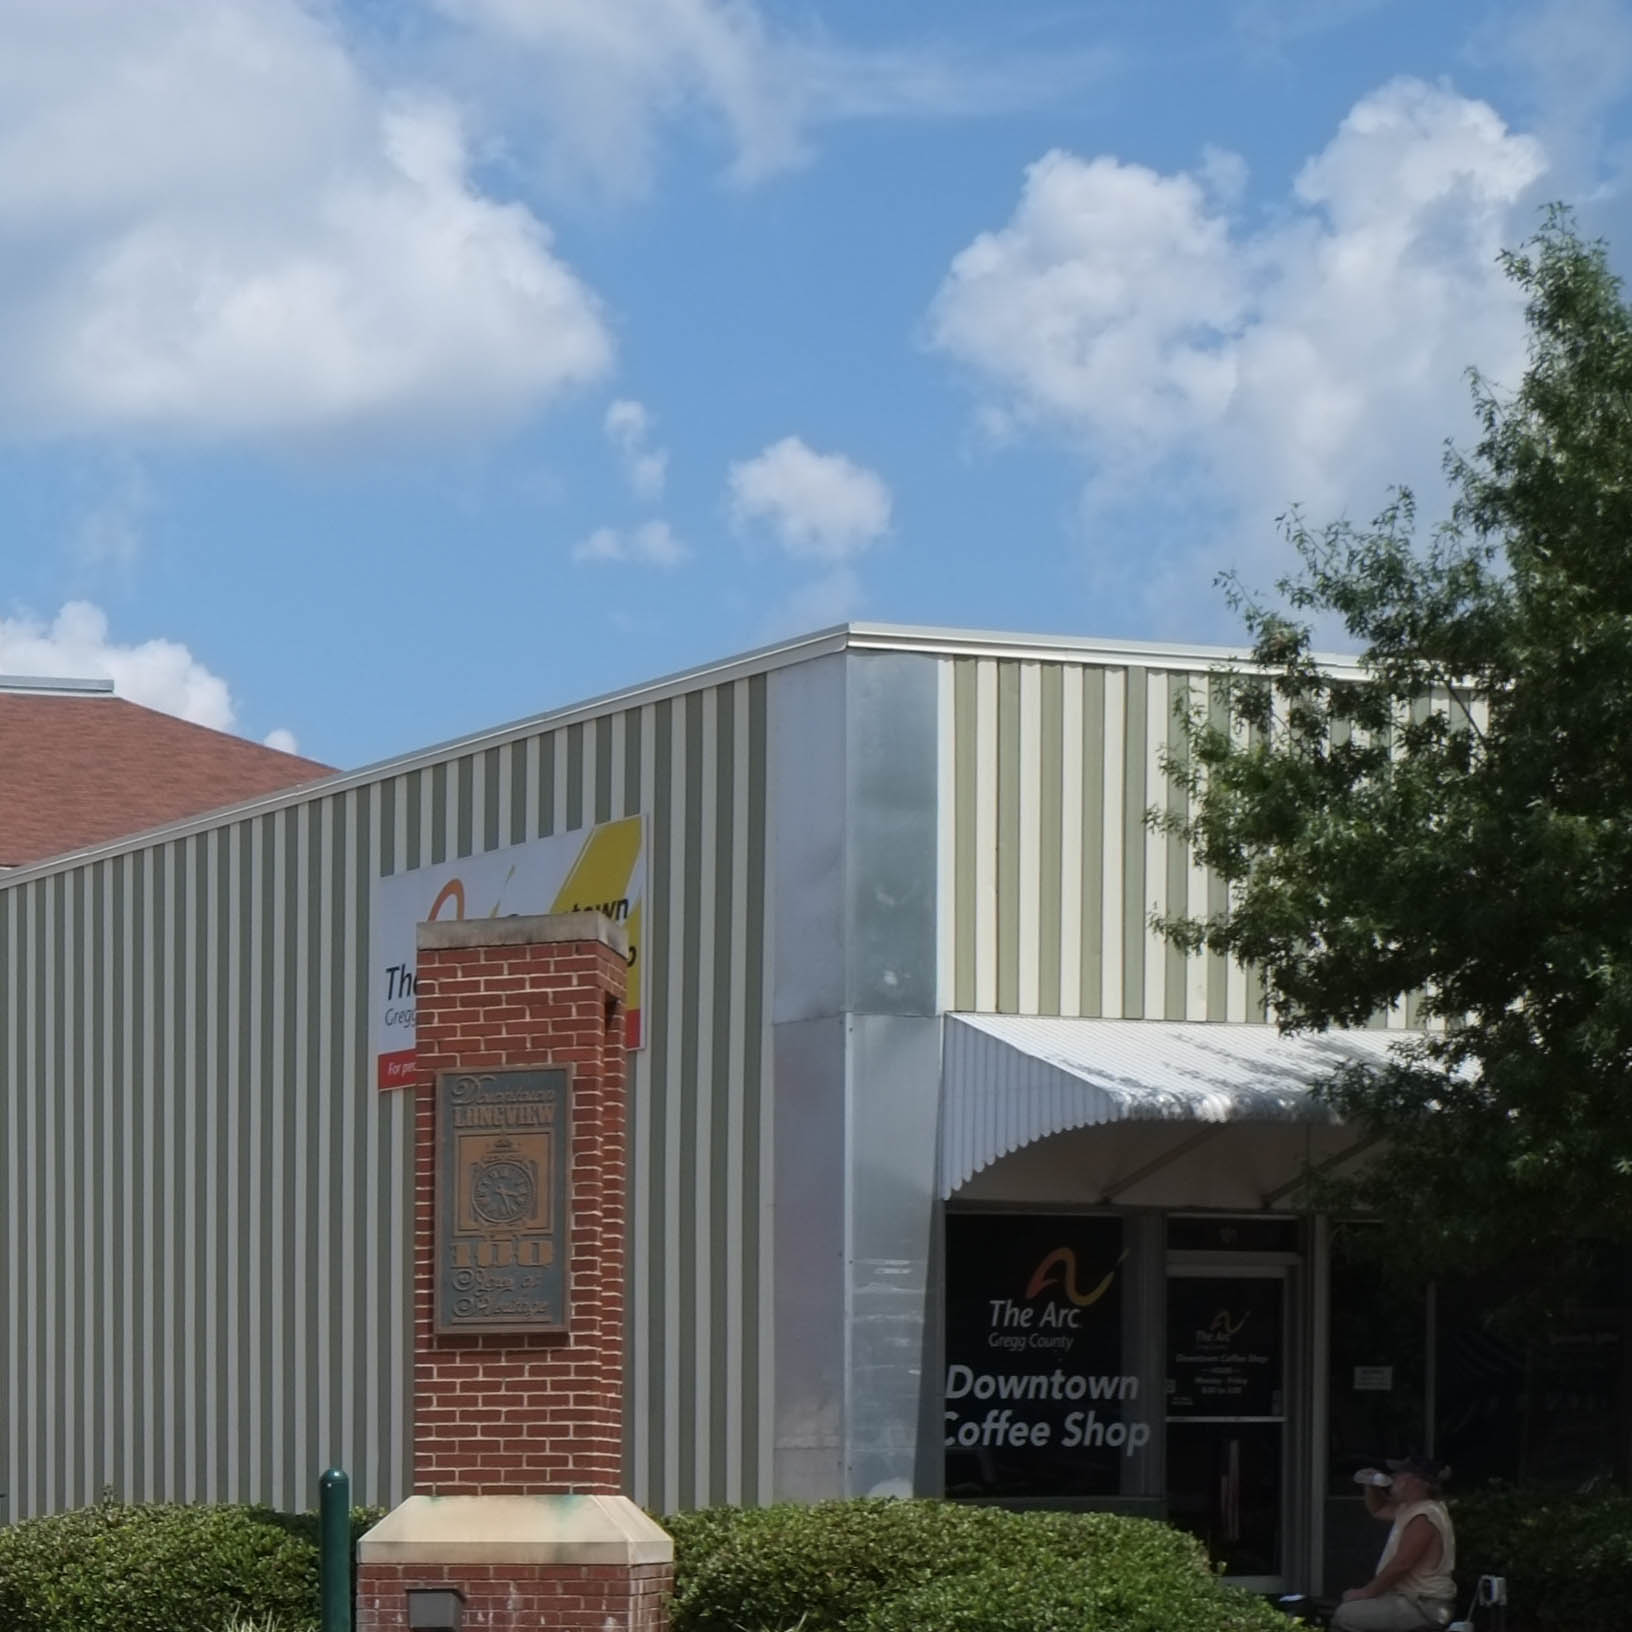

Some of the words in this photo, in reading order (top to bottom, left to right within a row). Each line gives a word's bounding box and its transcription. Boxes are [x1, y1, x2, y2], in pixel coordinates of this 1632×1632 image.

[385, 963, 416, 1001] Th
[449, 1239, 554, 1269] 100
[989, 1299, 1034, 1328] The
[1039, 1301, 1081, 1328] Arc
[988, 1332, 1026, 1351] Gregg
[1029, 1333, 1074, 1351] County
[945, 1364, 1140, 1400] Downtown
[1061, 1410, 1151, 1457] Shop
